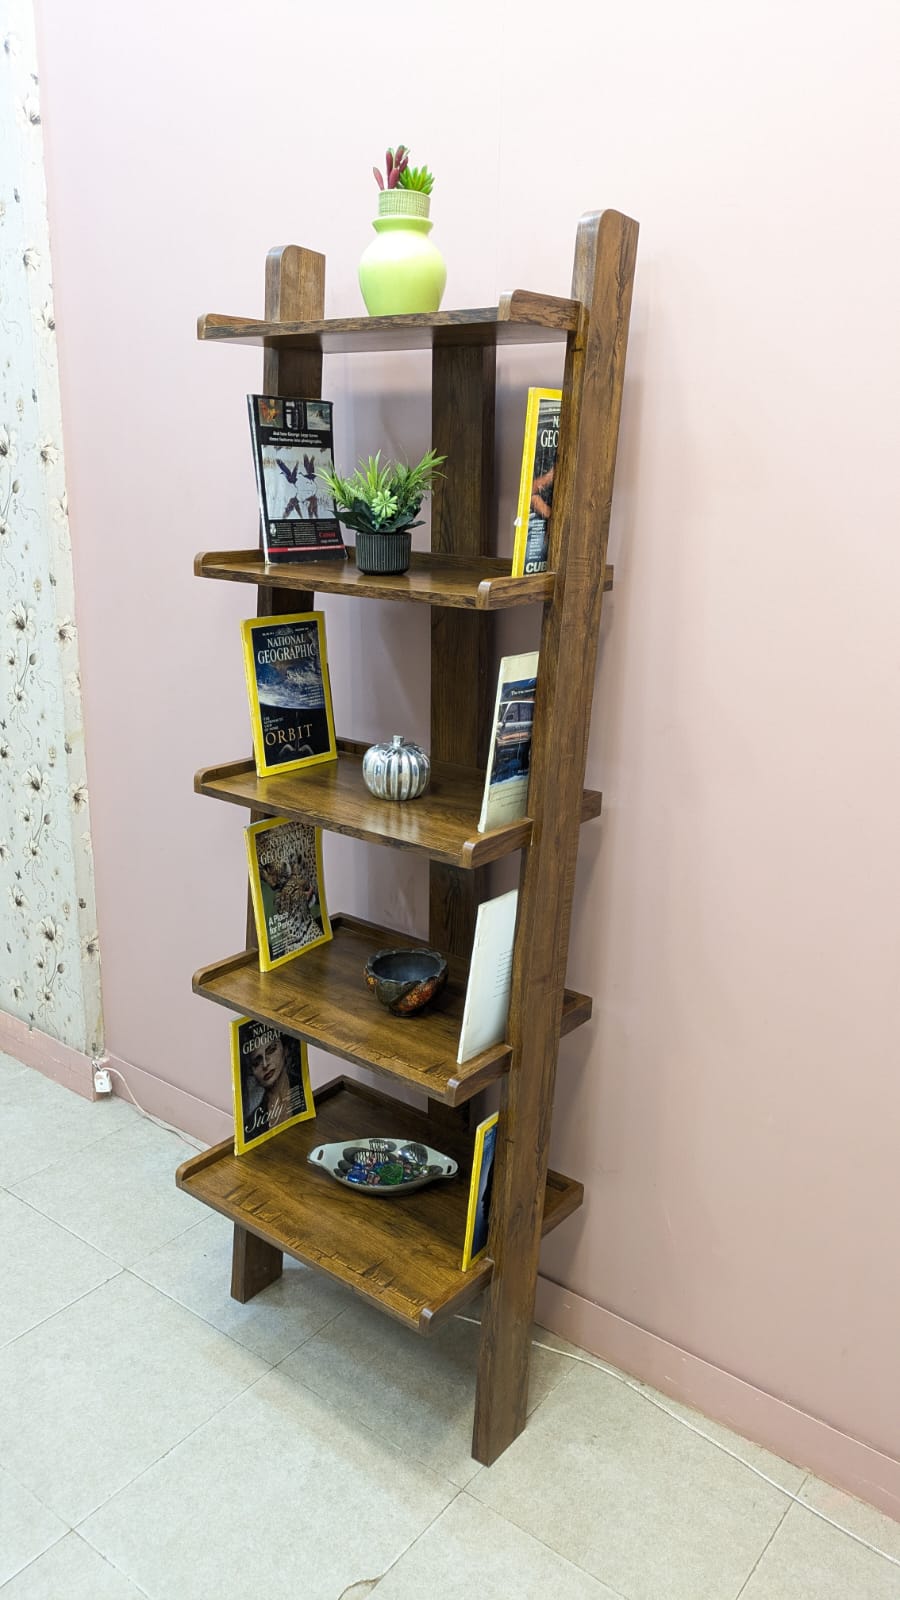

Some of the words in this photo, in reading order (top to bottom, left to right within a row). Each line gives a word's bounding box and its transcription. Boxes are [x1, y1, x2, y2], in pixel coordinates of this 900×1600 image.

[267, 633, 305, 648] NATIONAL
[257, 643, 316, 665] GEOGRAPHIC
[265, 723, 313, 746] ORBIT
[260, 836, 314, 866] GEOGRAPHIC
[269, 916, 274, 927] A
[245, 1097, 284, 1133] Sicily
